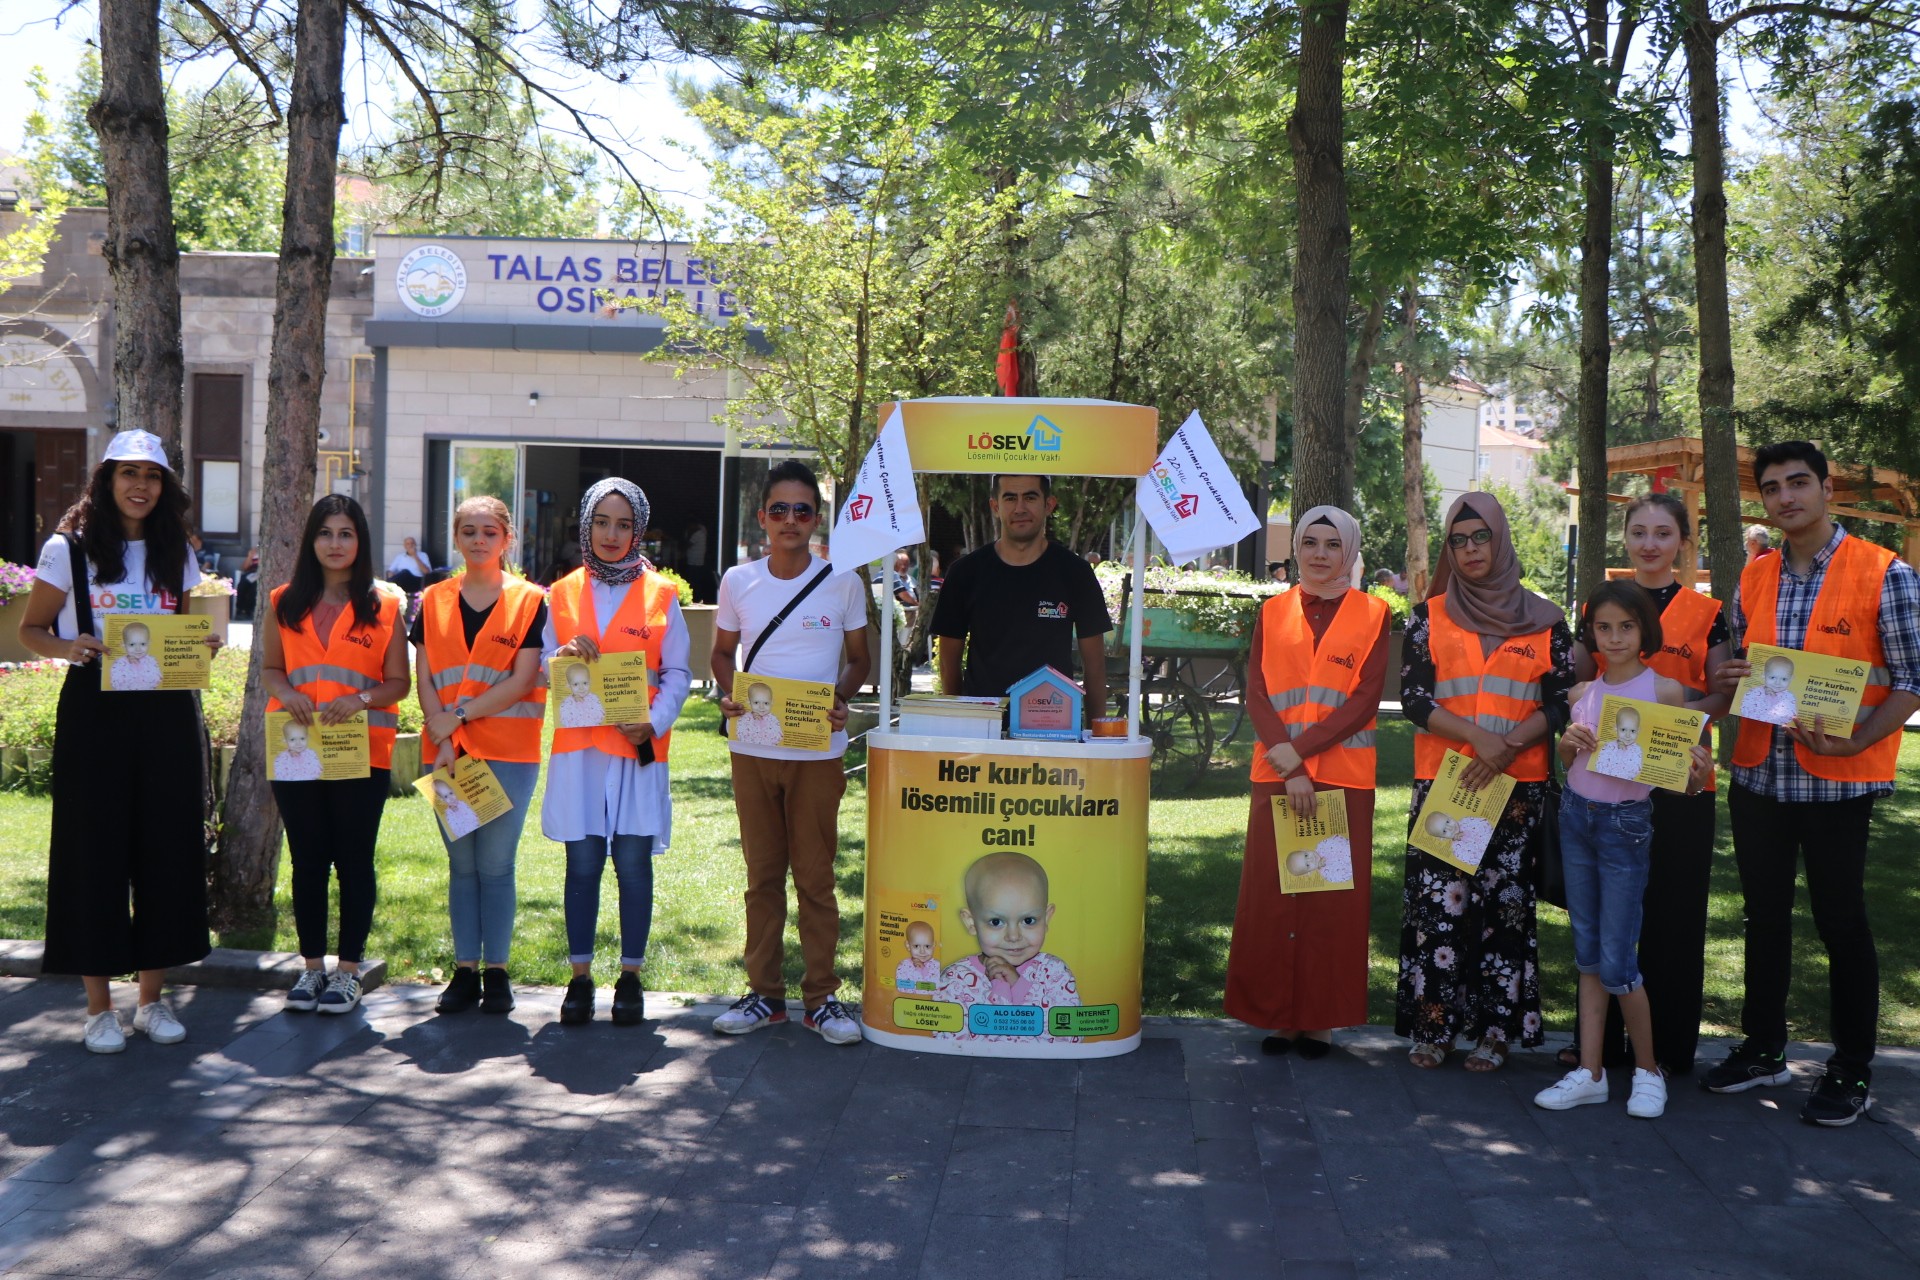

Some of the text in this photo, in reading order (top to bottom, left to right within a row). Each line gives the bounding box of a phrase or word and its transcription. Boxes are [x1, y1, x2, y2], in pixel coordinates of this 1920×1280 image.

[488, 254, 603, 283] TALAS
[968, 432, 1031, 450] LÖSEV
[967, 452, 1001, 460] Lösemili
[1003, 452, 1038, 462] Çocuklar
[1152, 461, 1181, 501] LÖSEV
[89, 590, 158, 609] LÖSEV
[1662, 644, 1681, 655] ÖSEV
[1801, 700, 1820, 708] can!
[1652, 730, 1665, 738] Her
[938, 759, 1085, 790] Her kurban,
[901, 787, 1119, 822] lösemili çocuklara
[981, 825, 1035, 847] can!
[915, 1004, 939, 1012] BANKA
[915, 1018, 939, 1026] LÖSEV
